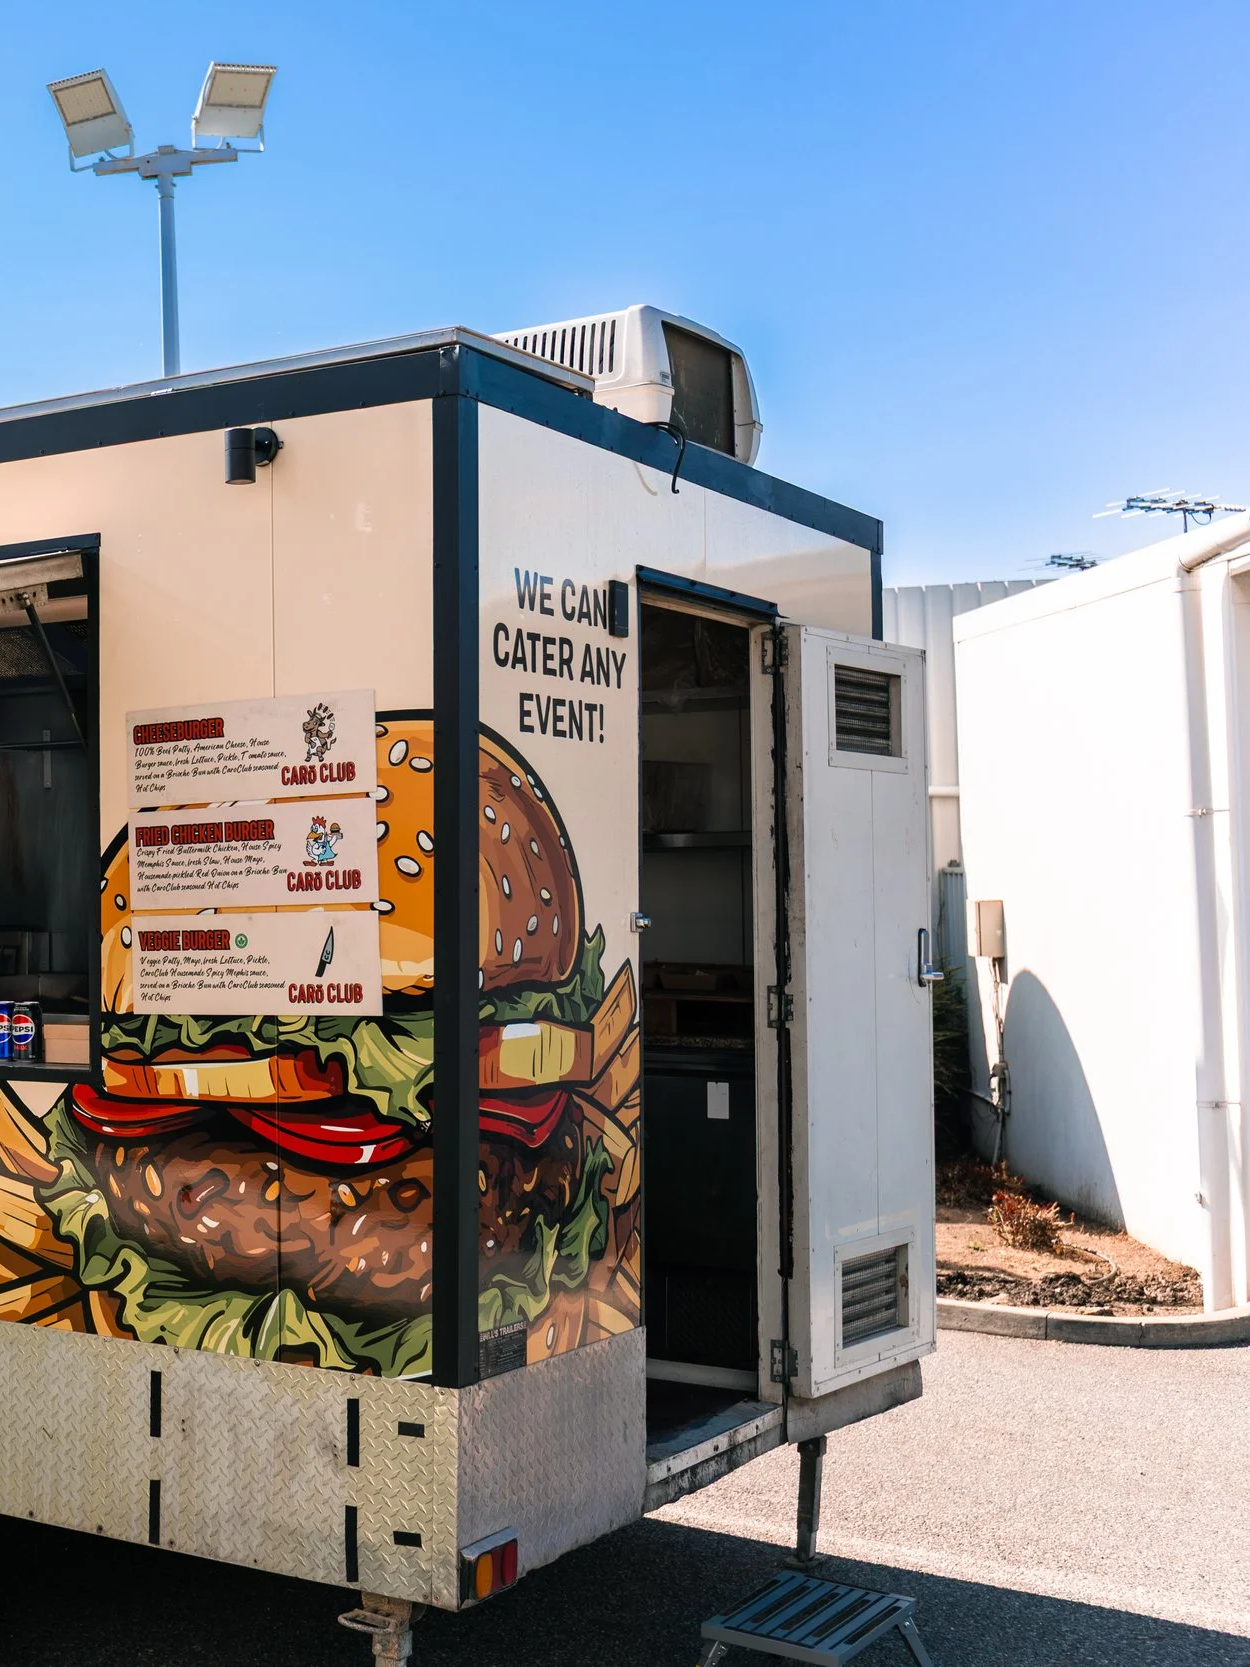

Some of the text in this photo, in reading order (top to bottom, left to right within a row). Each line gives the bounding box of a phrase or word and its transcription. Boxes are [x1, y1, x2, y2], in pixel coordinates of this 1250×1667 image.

[514, 567, 608, 630] WE CAN
[493, 622, 626, 689] CATER ANY
[519, 692, 604, 744] EVENT!
[133, 718, 224, 745] CHEESEBURGER
[135, 746, 155, 757] 100%
[156, 746, 171, 756] Beef
[194, 742, 224, 752] American
[249, 738, 270, 747] House
[134, 772, 152, 780] served
[166, 769, 190, 779] Brioche
[191, 767, 206, 777] Bun
[207, 767, 220, 775] with
[222, 764, 252, 774] CaroClub
[253, 762, 280, 772] seasoned
[135, 760, 156, 770] Burger
[320, 762, 356, 783] CLUB
[136, 783, 166, 792] Hot Chips
[136, 819, 275, 847] FRIED CHICKEN BURGER
[136, 848, 156, 858] Crispy
[156, 846, 176, 856] Fried
[176, 844, 212, 855] Buttermilk
[241, 842, 261, 852] House
[262, 841, 282, 852] Spicy
[137, 860, 164, 869] Memphis
[223, 856, 243, 864] House
[138, 872, 172, 880] Housemade
[172, 870, 194, 880] pickled
[195, 869, 210, 878] Red
[244, 866, 270, 876] Brioche
[272, 865, 287, 875] Bun
[326, 868, 361, 890] CLUB
[137, 880, 240, 892] with CaroClub seasoned Hot Chips
[138, 930, 230, 951] VEGGIE BURGER
[140, 956, 161, 967] Veggie
[140, 968, 169, 978] CaroClub
[170, 968, 204, 977] Housemade
[206, 968, 224, 978] Spicy
[140, 981, 158, 989] served
[171, 980, 195, 990] Brioche
[196, 980, 212, 990] Bun
[212, 981, 226, 989] with
[228, 980, 258, 990] CaroClub
[259, 981, 286, 989] seasoned
[327, 982, 364, 1004] CLUB
[141, 992, 171, 1002] Hot Chips
